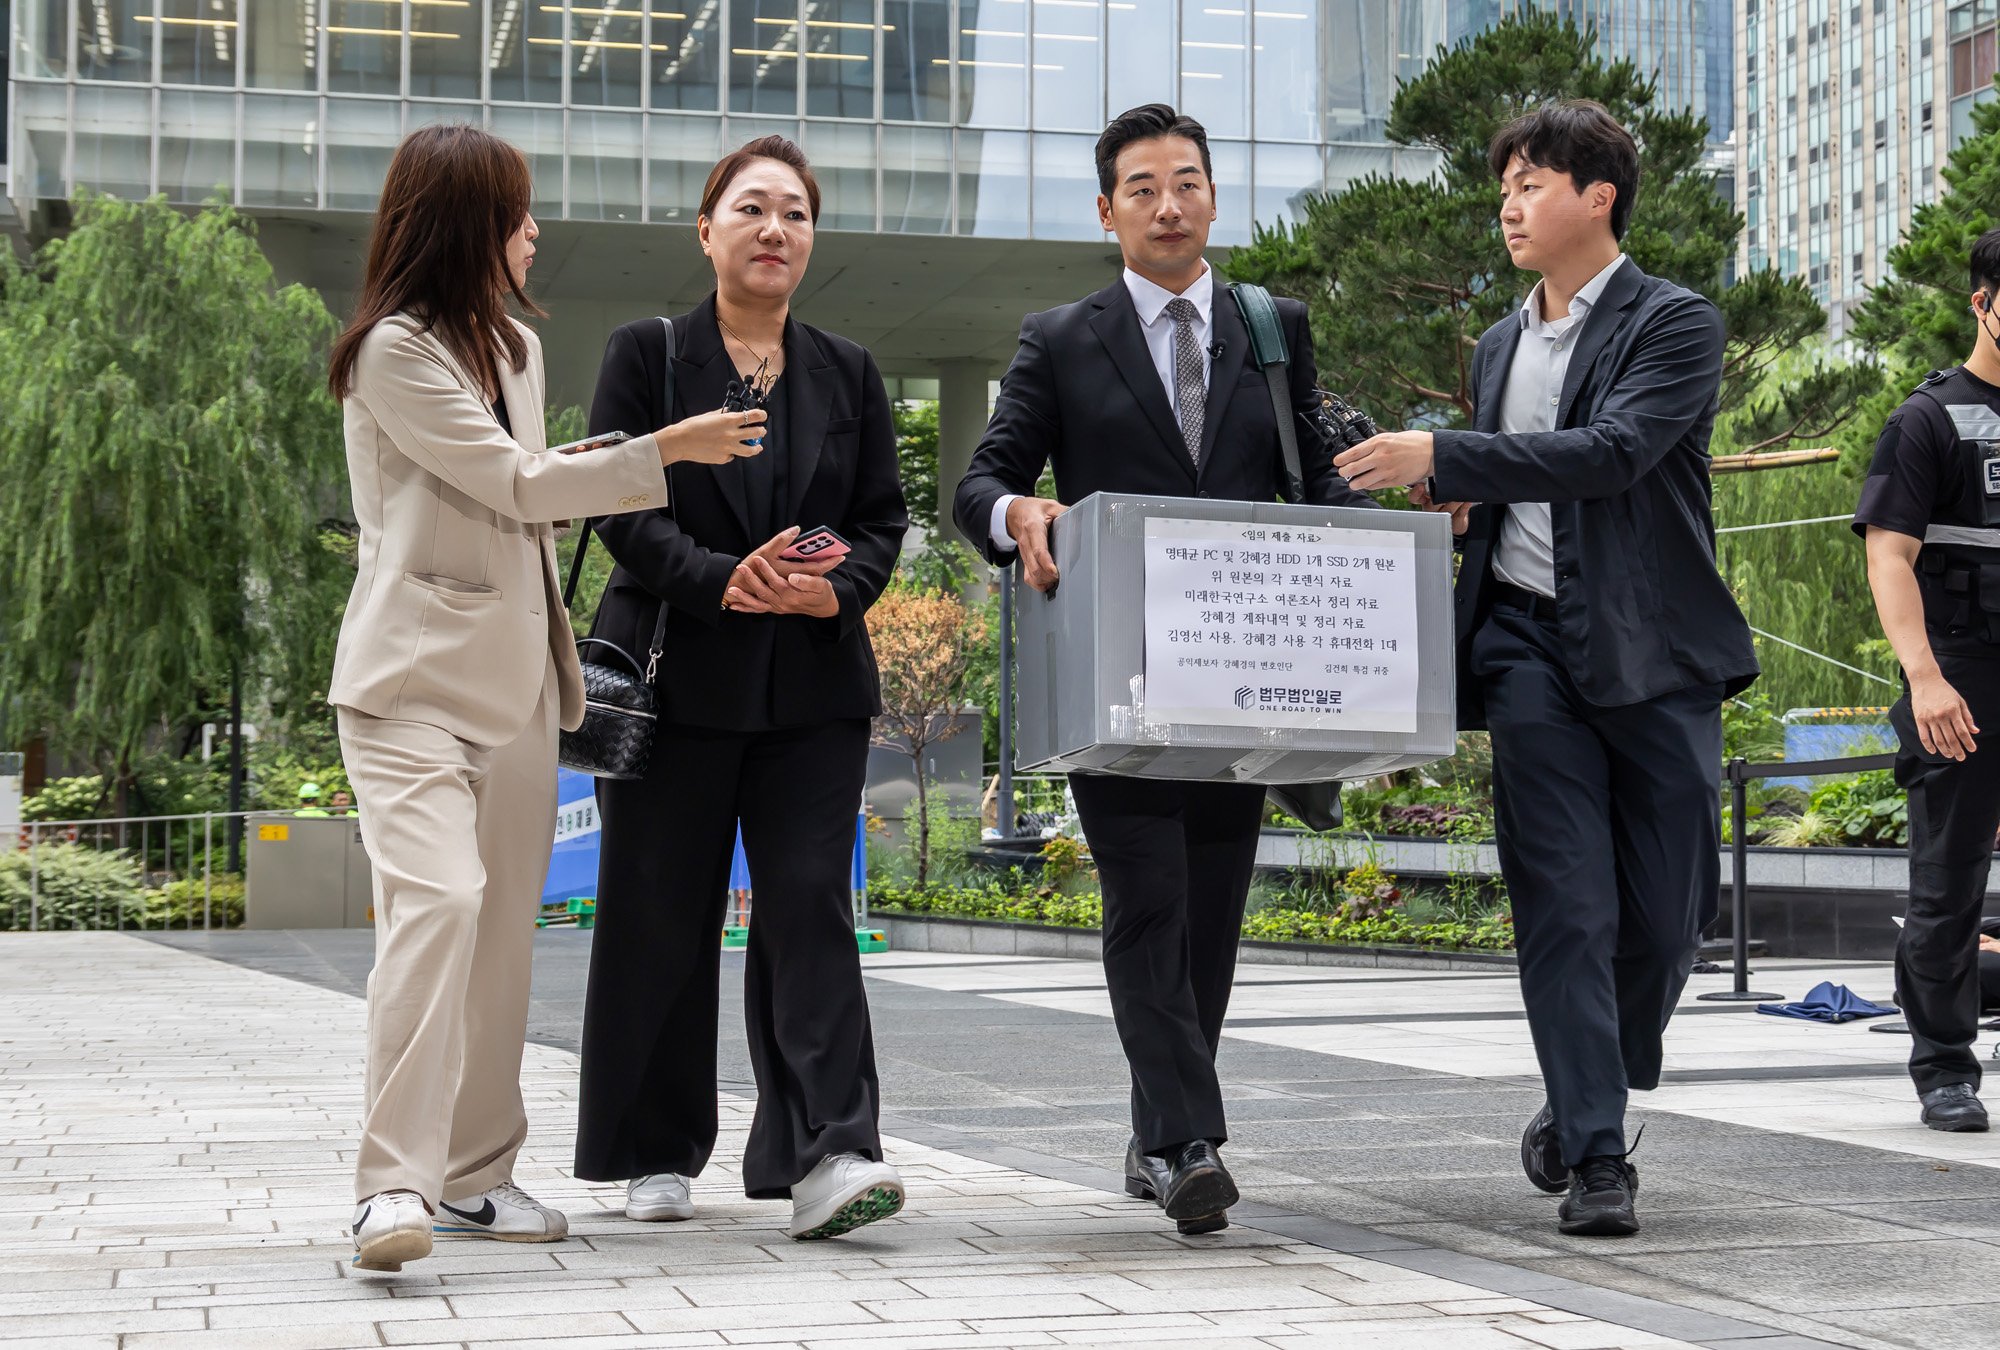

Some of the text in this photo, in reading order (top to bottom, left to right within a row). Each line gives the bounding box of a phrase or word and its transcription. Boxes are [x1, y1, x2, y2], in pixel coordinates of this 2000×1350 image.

[1271, 531, 1292, 543] 제출
[1165, 547, 1396, 572] 명태균 PC 및 강혜경 HDD 1개 SSD 2개 원본
[1211, 569, 1354, 589] 위 원본의 각 포렌식 자료
[1184, 589, 1380, 611] 미래한국연구소 여론조사 정리 자료
[1200, 610, 1366, 630] 강혜경 계좌내역 및 정리 자료
[1167, 629, 1202, 644] 김영선
[1242, 632, 1276, 647] 강혜경
[1282, 634, 1306, 648] 사용
[1311, 635, 1324, 649] 각
[1328, 636, 1375, 651] 휴대전화
[1380, 639, 1397, 653] 1대
[1177, 657, 1389, 676] 공익제보자 강혜경의 변호인단 김건희 특검 귀중
[1259, 687, 1342, 705] 법무법인일로
